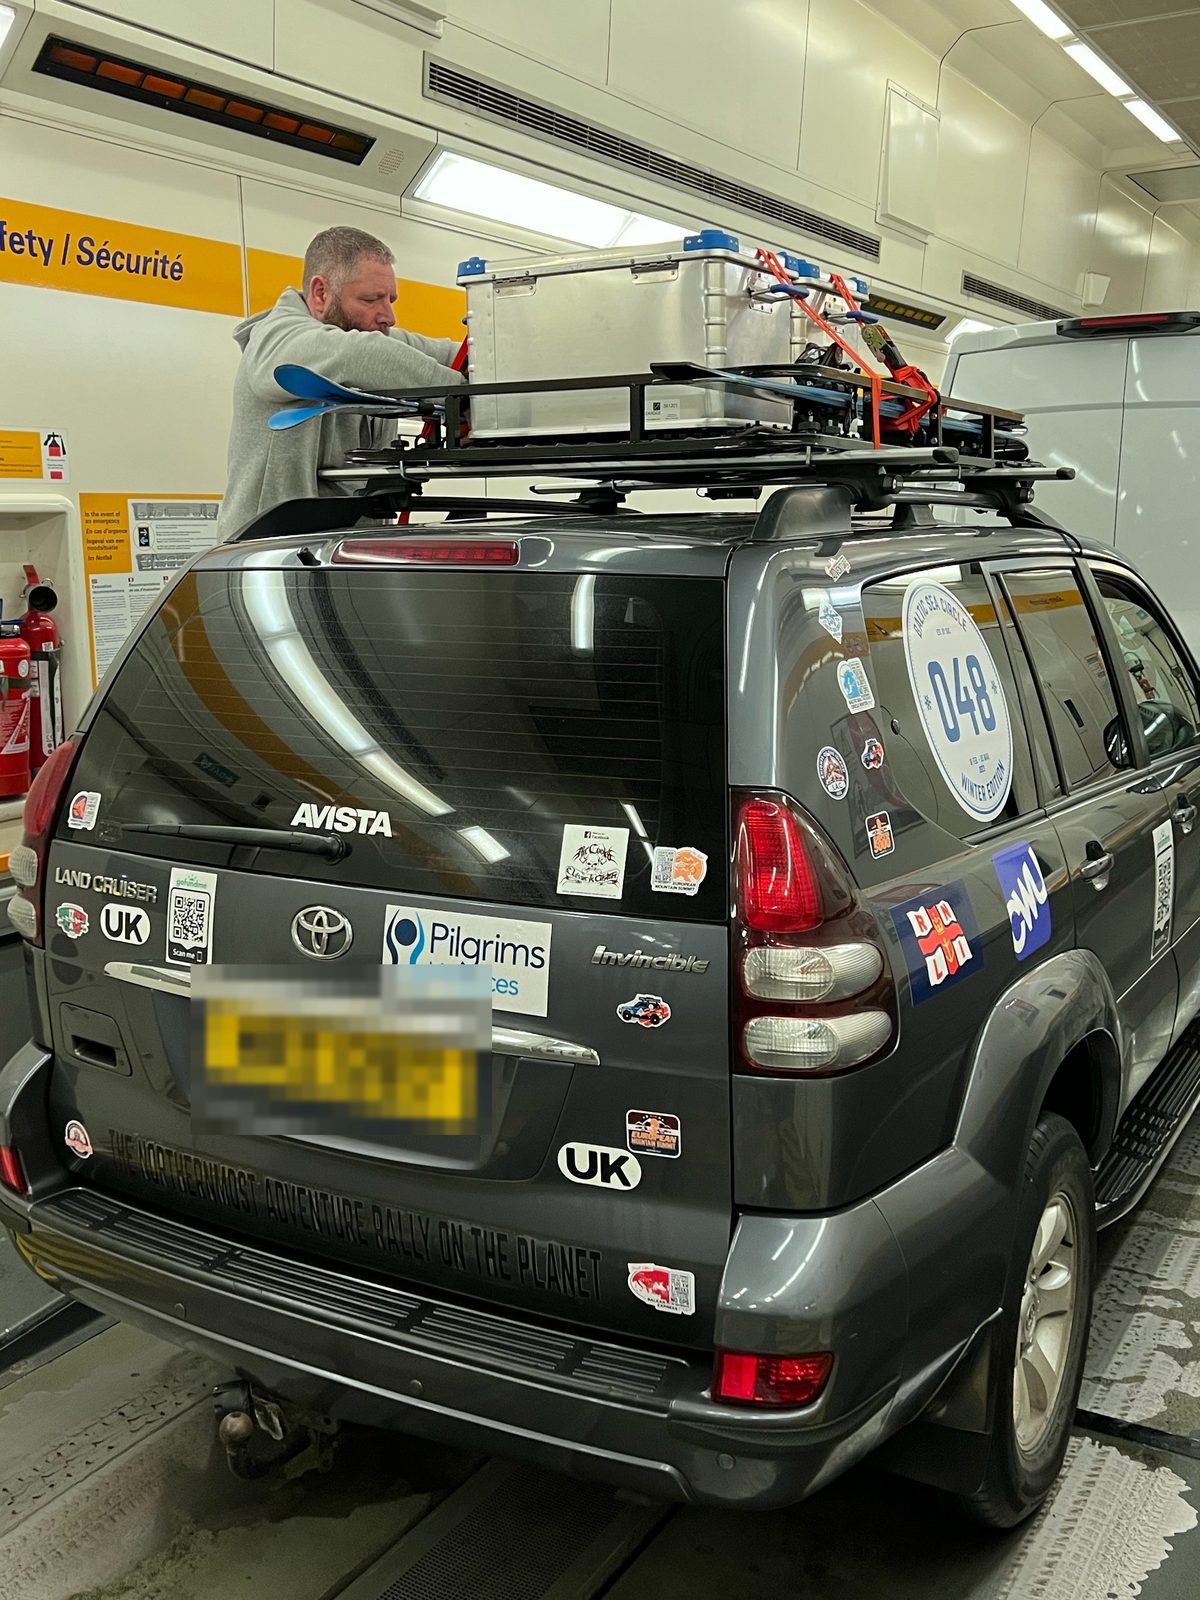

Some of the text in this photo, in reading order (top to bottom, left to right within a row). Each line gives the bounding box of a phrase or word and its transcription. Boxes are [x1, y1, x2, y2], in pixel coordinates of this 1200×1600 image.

[76, 236, 184, 281] Sécurité
[913, 596, 968, 638] BALTIC SEA CIRCLE
[928, 654, 996, 742] 048
[961, 759, 1005, 802] WINTER EDITION
[290, 802, 393, 838] AVISTA
[55, 866, 158, 903] LAND CRUISER
[176, 878, 208, 889] gofundme
[105, 909, 142, 943] UK
[430, 922, 545, 969] Pilgrims
[172, 949, 184, 958] Scan
[592, 945, 711, 974] Invincible
[566, 1147, 631, 1187] UK
[108, 1128, 601, 1300] THE NORTHERNMOST ADVENTURE RALLY ON THE PLANET
